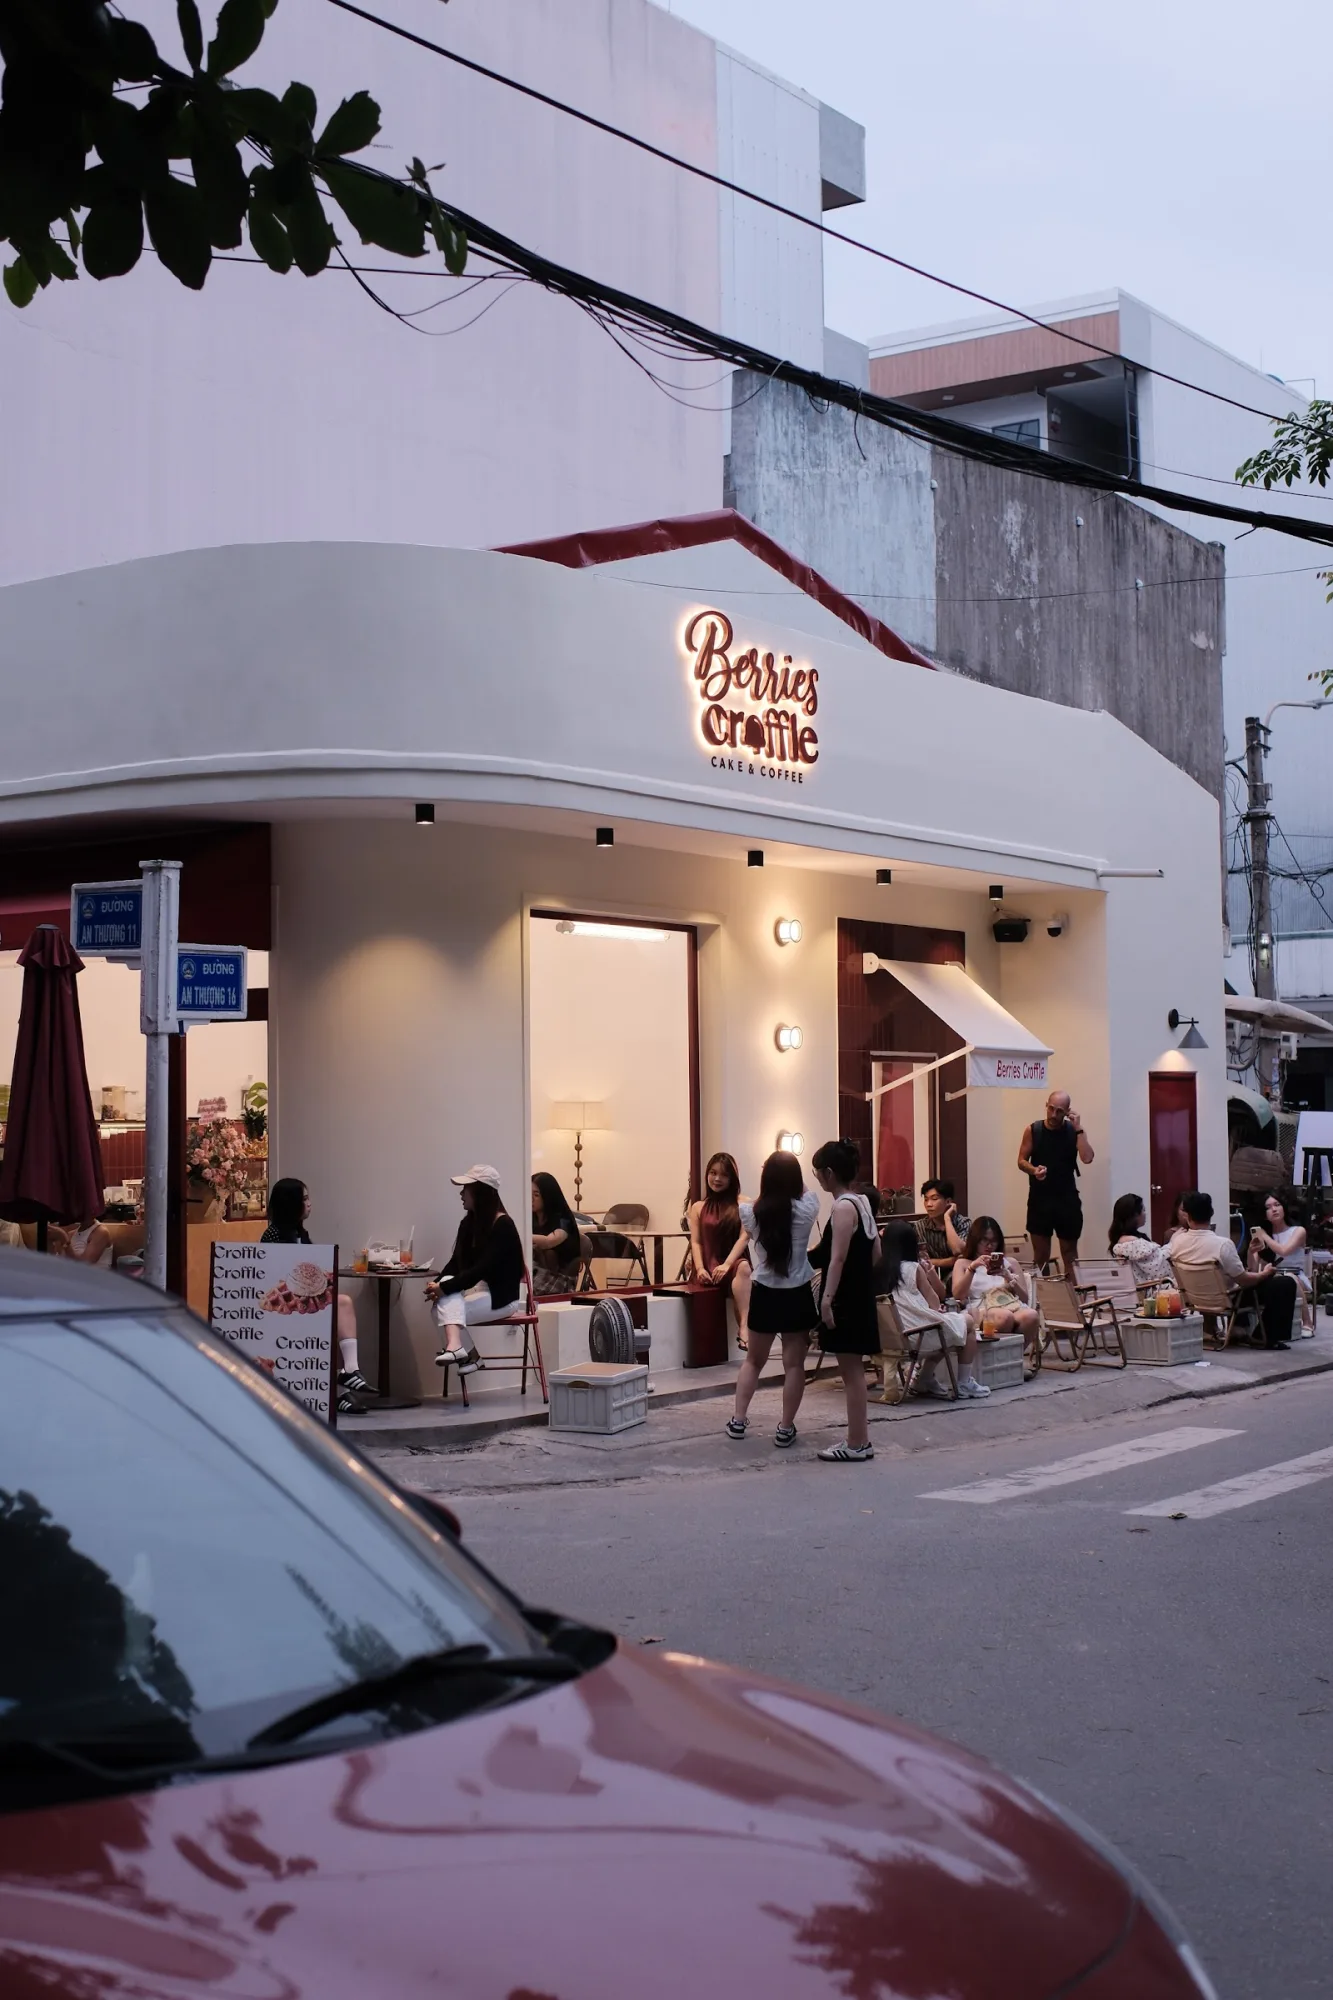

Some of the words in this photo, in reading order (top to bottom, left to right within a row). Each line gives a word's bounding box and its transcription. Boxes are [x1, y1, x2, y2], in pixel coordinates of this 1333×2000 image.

[685, 611, 819, 716] Berries
[711, 756, 743, 772] CAKE
[748, 763, 755, 775] &
[760, 765, 803, 784] COFFEE
[101, 895, 134, 913] ĐƯỜNG
[81, 924, 92, 944] AN
[127, 924, 137, 943] 11
[202, 958, 235, 975] ĐƯỜNG
[181, 986, 193, 1005] AN
[227, 987, 237, 1006] 16
[996, 1060, 1021, 1079] Berries
[1023, 1062, 1045, 1079] Croffle
[214, 1245, 266, 1260] Croffle
[213, 1265, 266, 1280] Croffle
[212, 1285, 265, 1300] Croffle
[212, 1305, 265, 1320] Croffle
[275, 1336, 329, 1351] Croffle
[275, 1356, 329, 1371] Croffle
